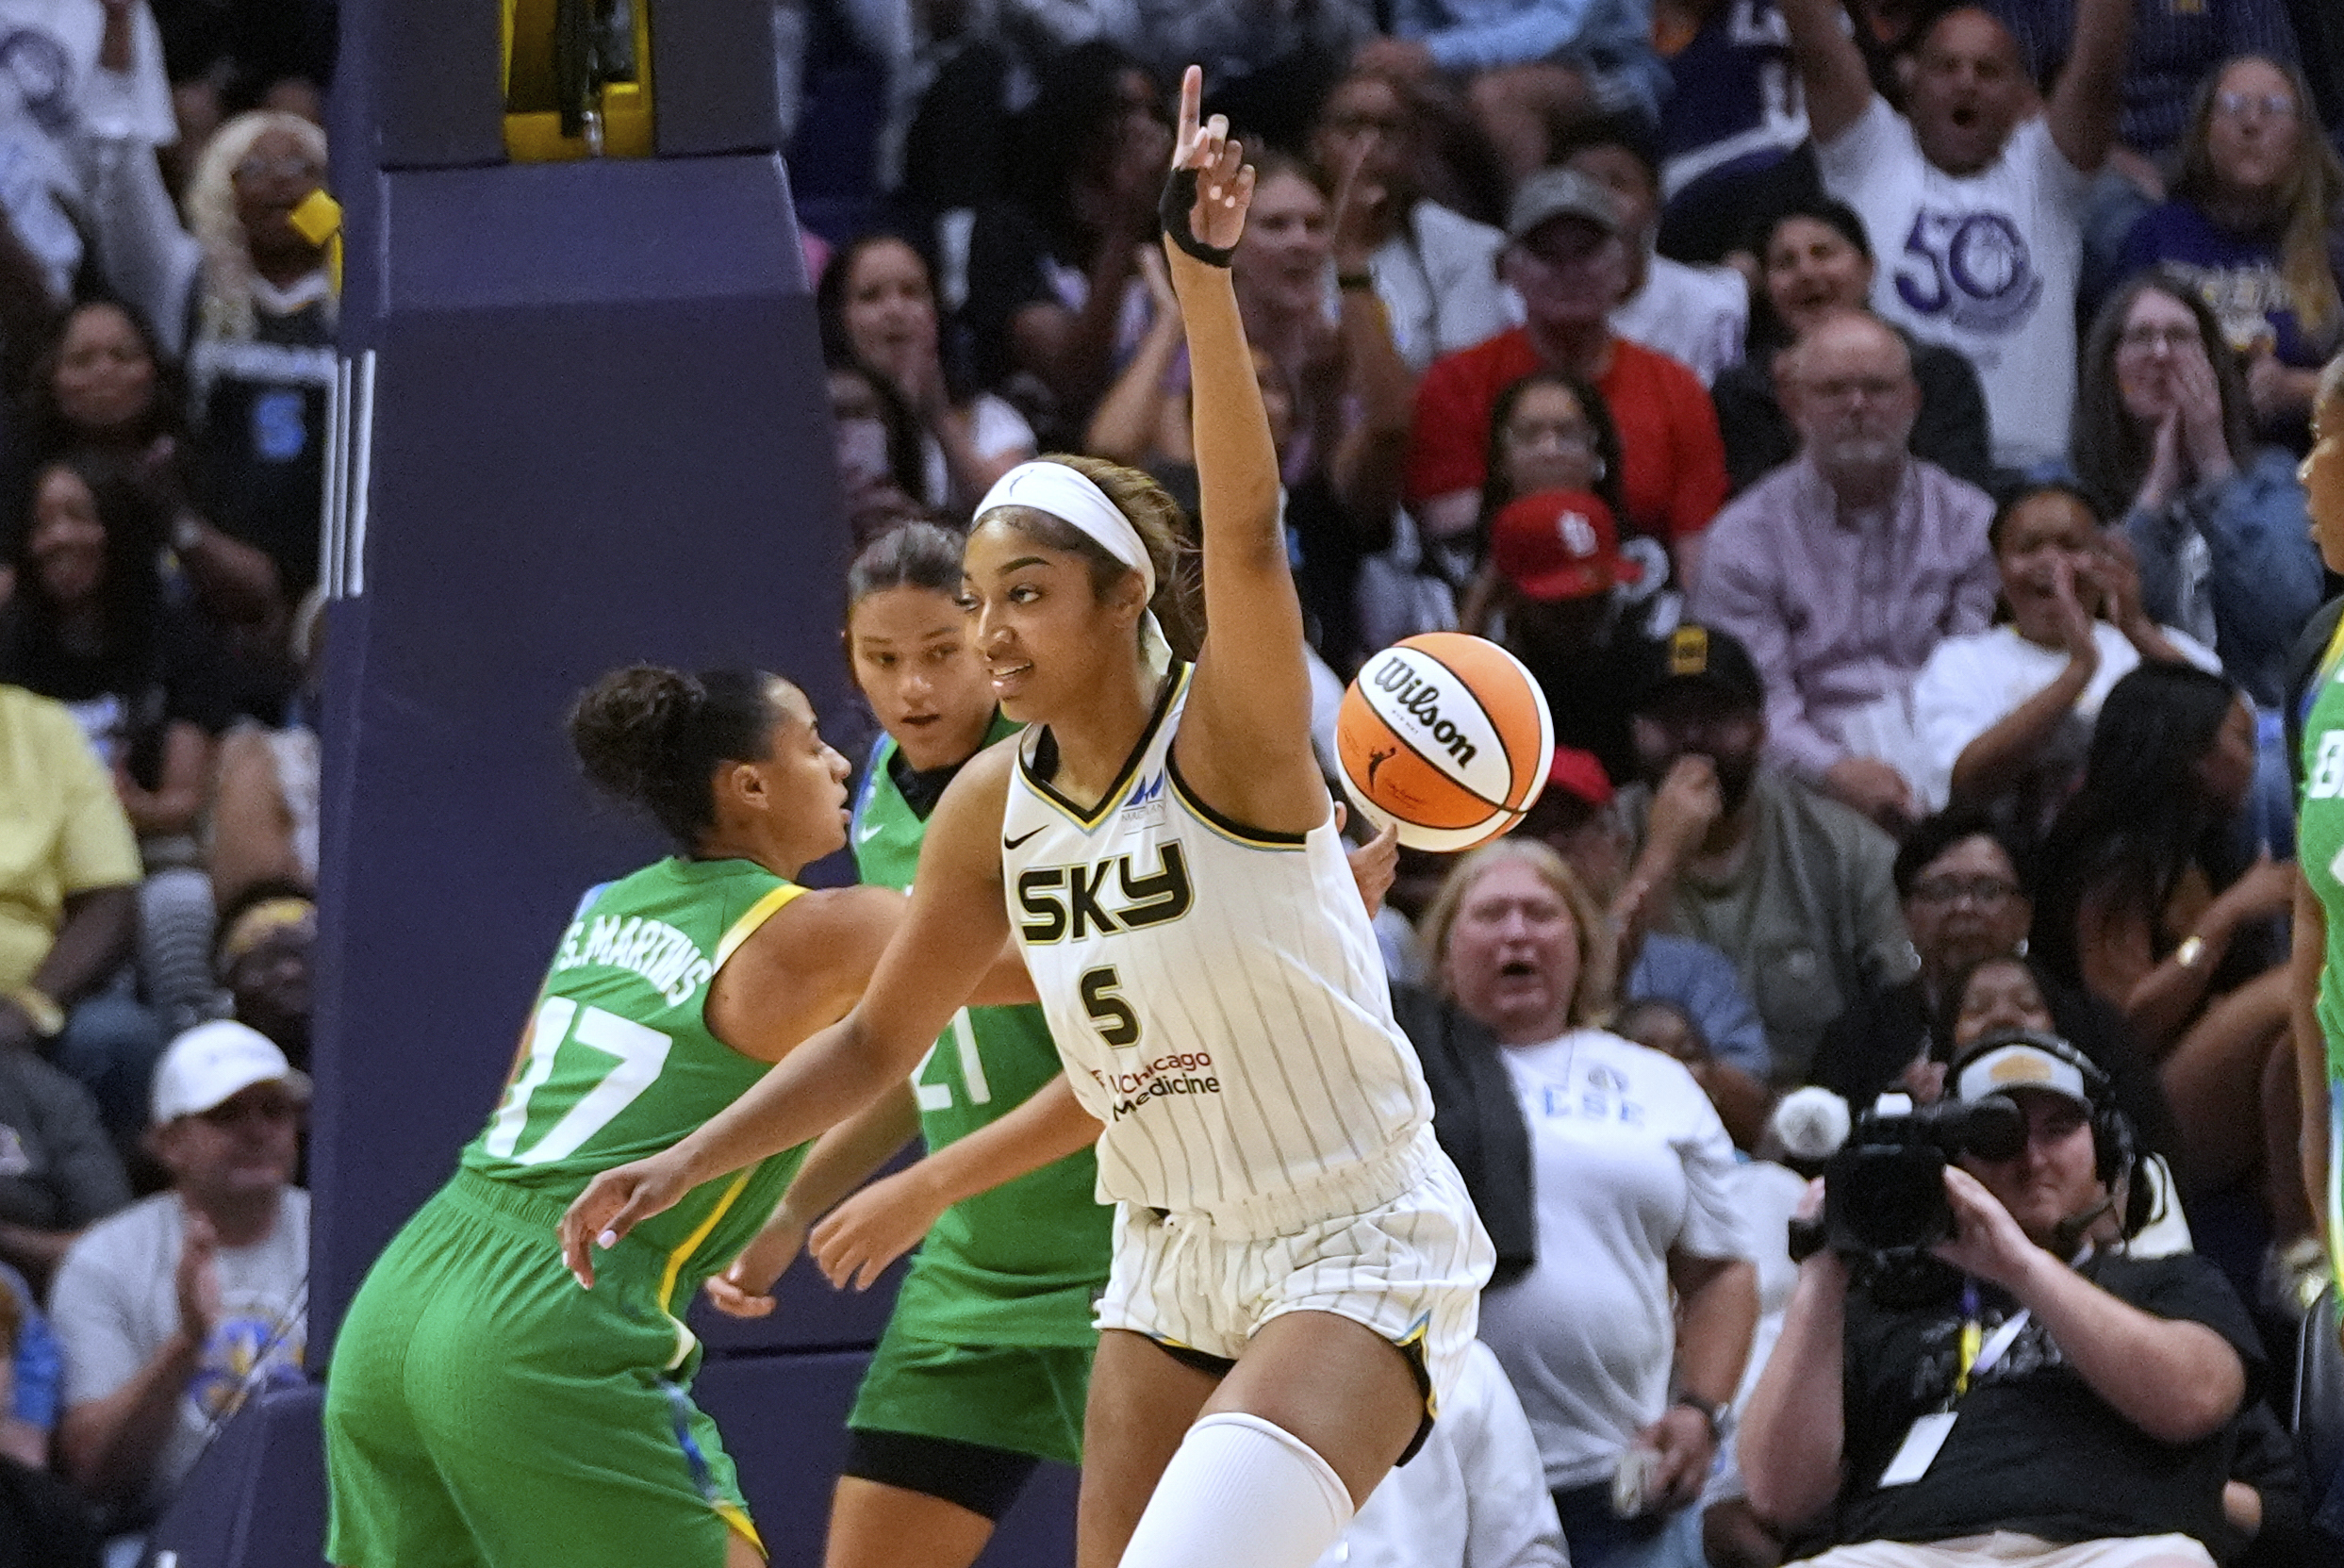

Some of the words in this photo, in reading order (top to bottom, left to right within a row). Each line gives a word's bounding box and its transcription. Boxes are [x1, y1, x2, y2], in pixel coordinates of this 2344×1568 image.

[1895, 209, 2027, 313] 50
[1375, 656, 1477, 769] Wilson
[1017, 838, 1195, 946] SKY
[1079, 964, 1143, 1049] 5
[486, 996, 672, 1165] 17
[1113, 1072, 1221, 1122] Medicine
